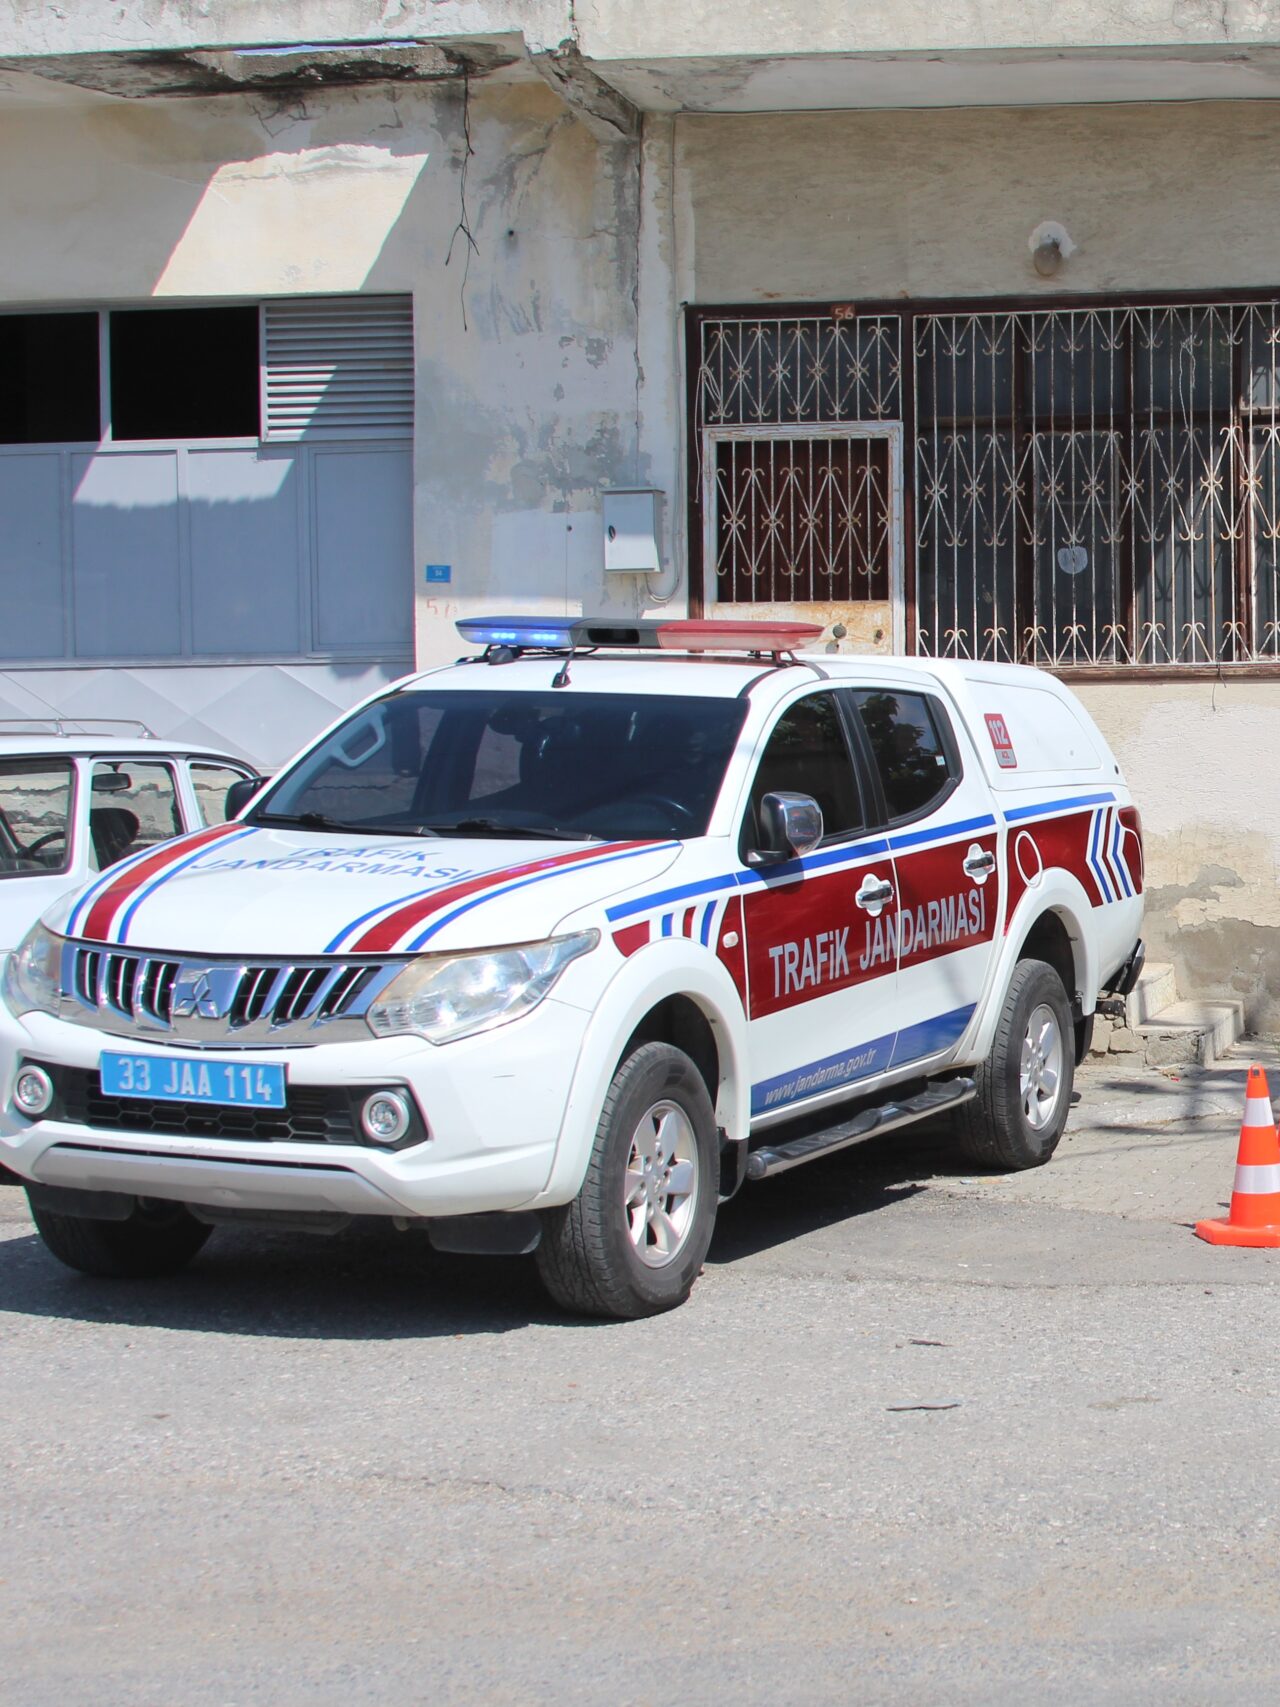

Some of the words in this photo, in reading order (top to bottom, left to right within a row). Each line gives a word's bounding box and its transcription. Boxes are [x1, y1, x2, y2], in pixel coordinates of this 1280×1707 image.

[834, 306, 855, 320] 56
[988, 719, 1010, 744] 112
[190, 858, 475, 880] JANDARMASI
[859, 887, 985, 971] JANDARMASI
[117, 1057, 151, 1092] 33
[163, 1061, 213, 1098] JAA
[223, 1065, 273, 1102] 114
[764, 1048, 877, 1104] www.jandarma.gov.tr
